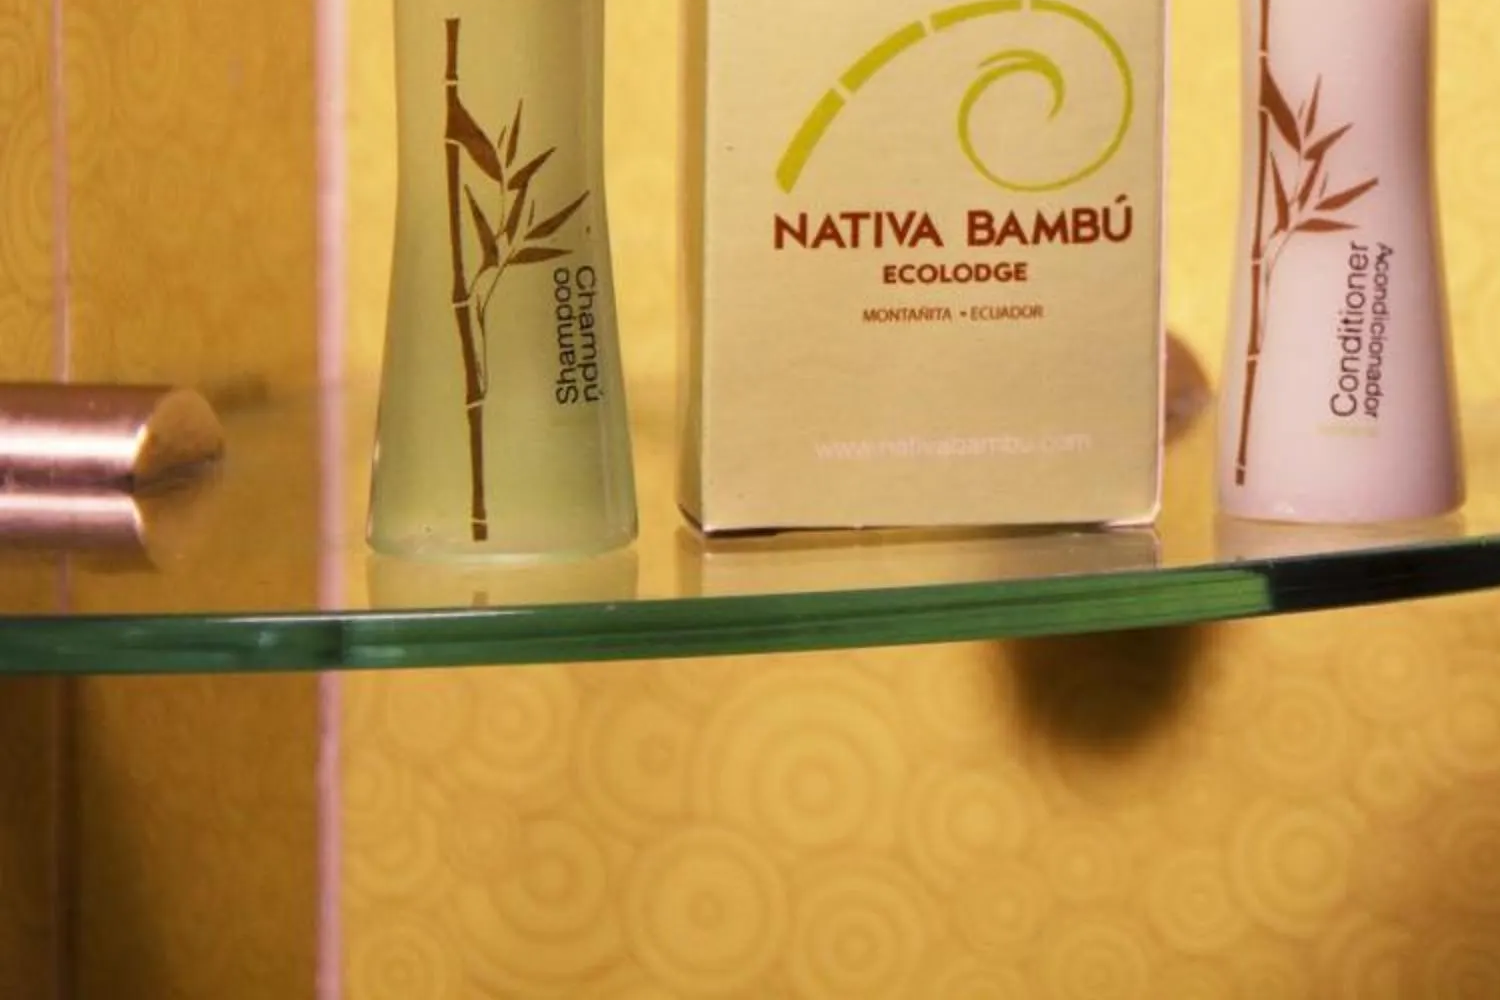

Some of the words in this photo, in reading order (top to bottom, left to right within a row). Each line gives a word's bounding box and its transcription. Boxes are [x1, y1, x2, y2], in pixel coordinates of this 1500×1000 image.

[773, 210, 944, 249] NATIVA
[966, 194, 1133, 247] BAMBÚ
[883, 262, 1028, 285] ECOLODGE
[553, 267, 579, 404] Shampoo
[575, 265, 604, 402] Champú
[863, 305, 952, 323] MONTAÑITA
[970, 304, 1044, 322] ECUADOR
[1329, 240, 1370, 418] Conditioner
[1363, 241, 1395, 419] Acondicionador
